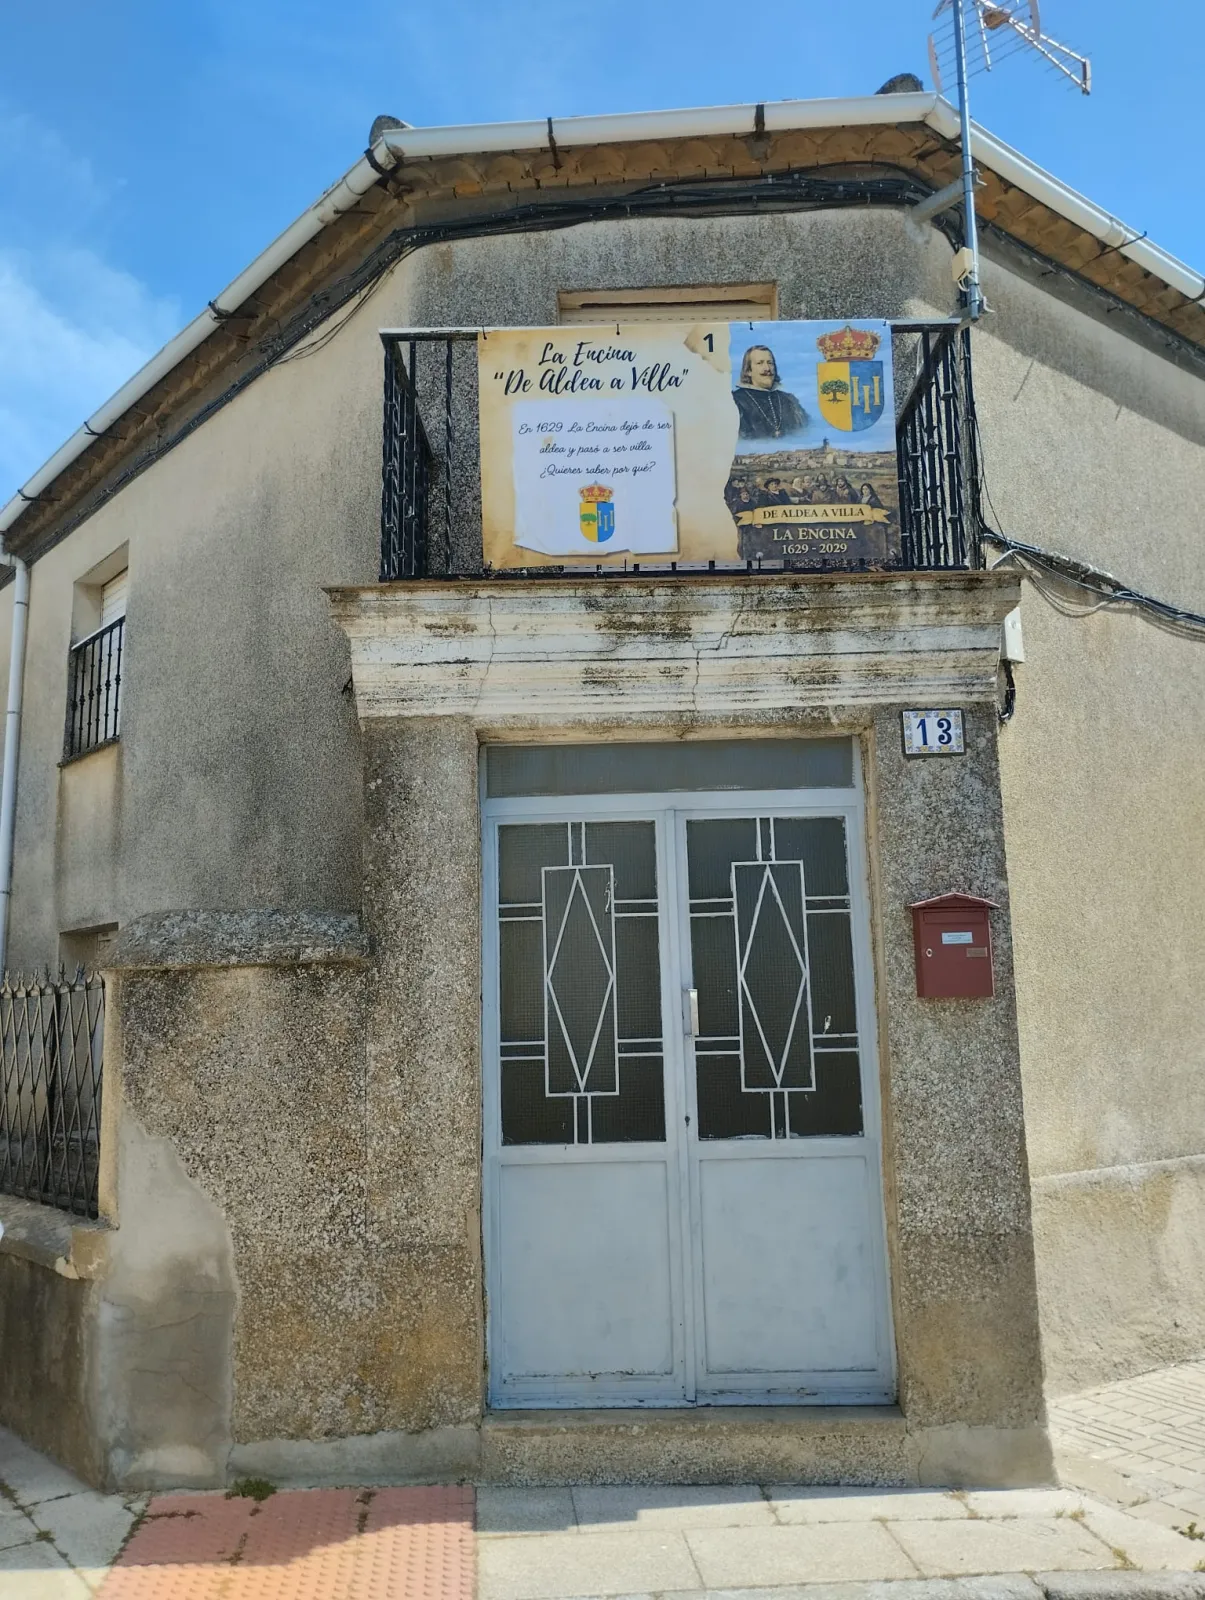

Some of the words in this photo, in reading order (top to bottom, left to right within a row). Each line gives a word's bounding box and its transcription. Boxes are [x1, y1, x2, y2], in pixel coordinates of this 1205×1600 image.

[703, 333, 714, 352] 1
[539, 342, 567, 366] La
[573, 341, 637, 366] Encina
[539, 366, 605, 395] Aldea
[610, 377, 625, 390] a
[518, 423, 533, 434] En
[536, 421, 563, 433] 1629
[567, 421, 583, 433] La
[586, 421, 617, 433] Encina
[620, 420, 639, 435] dejó
[642, 420, 655, 430] de
[657, 421, 672, 430] ser
[539, 443, 566, 454] aldea
[568, 446, 576, 457] y
[577, 444, 600, 456] pasó
[613, 444, 627, 453] ser
[629, 442, 652, 452] villa
[539, 464, 582, 479] ¿Quieres
[586, 463, 610, 475] saber
[612, 465, 630, 477] por
[632, 461, 657, 476] qué?
[763, 509, 779, 520] DE
[781, 508, 818, 518] ALDEA
[821, 508, 829, 517] A
[831, 507, 865, 517] VILLA
[772, 529, 793, 541] LA
[798, 527, 857, 540] ENCINA
[782, 544, 809, 555] 1629
[819, 543, 848, 554] 2029
[916, 718, 952, 745] 13
